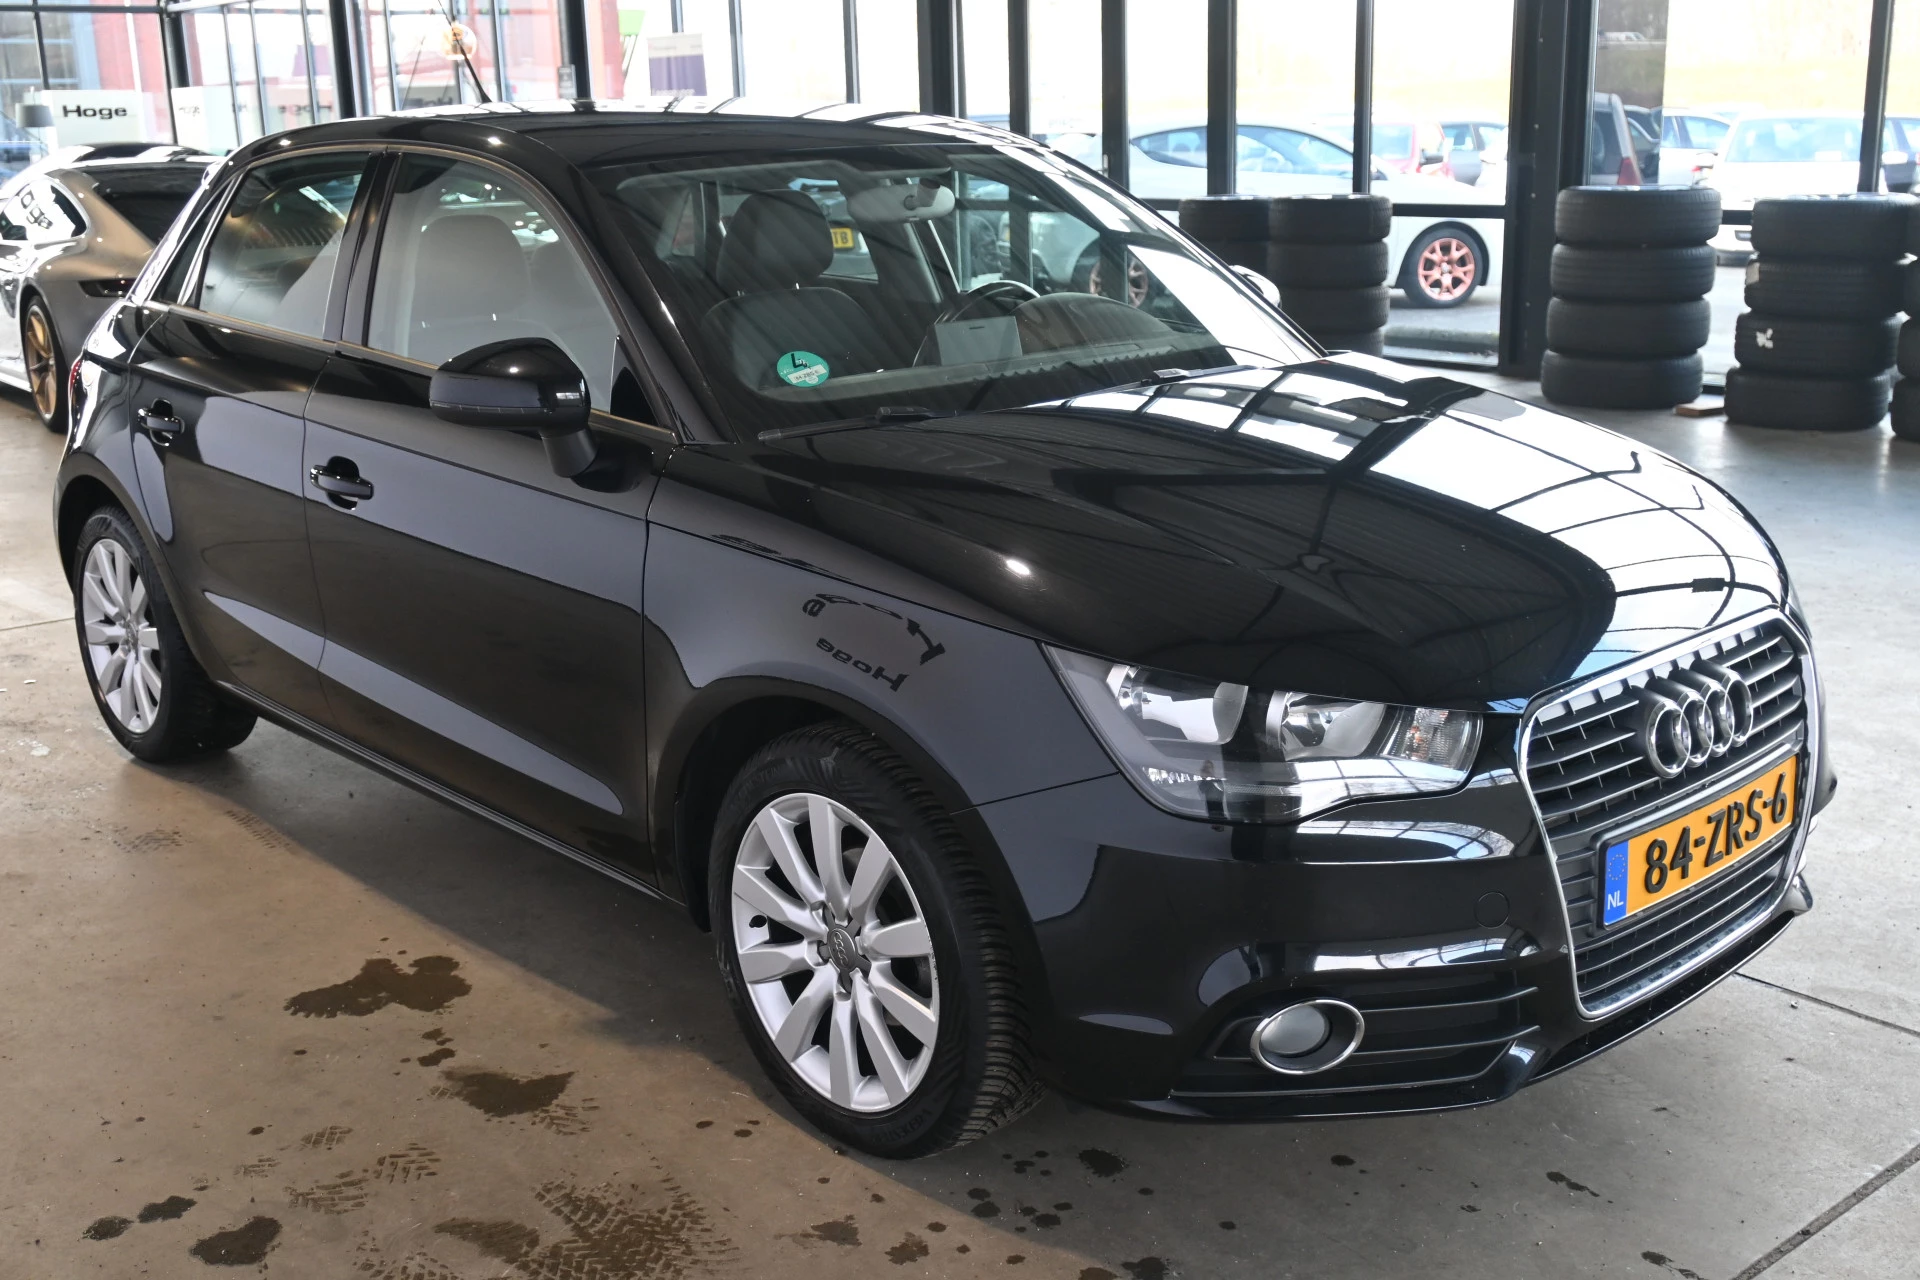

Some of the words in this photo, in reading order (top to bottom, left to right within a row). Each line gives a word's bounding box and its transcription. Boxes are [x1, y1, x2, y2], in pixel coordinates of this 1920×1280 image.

[62, 105, 128, 120] Hoge
[1644, 772, 1788, 894] 84-ZRS-6
[1607, 890, 1624, 910] NL
